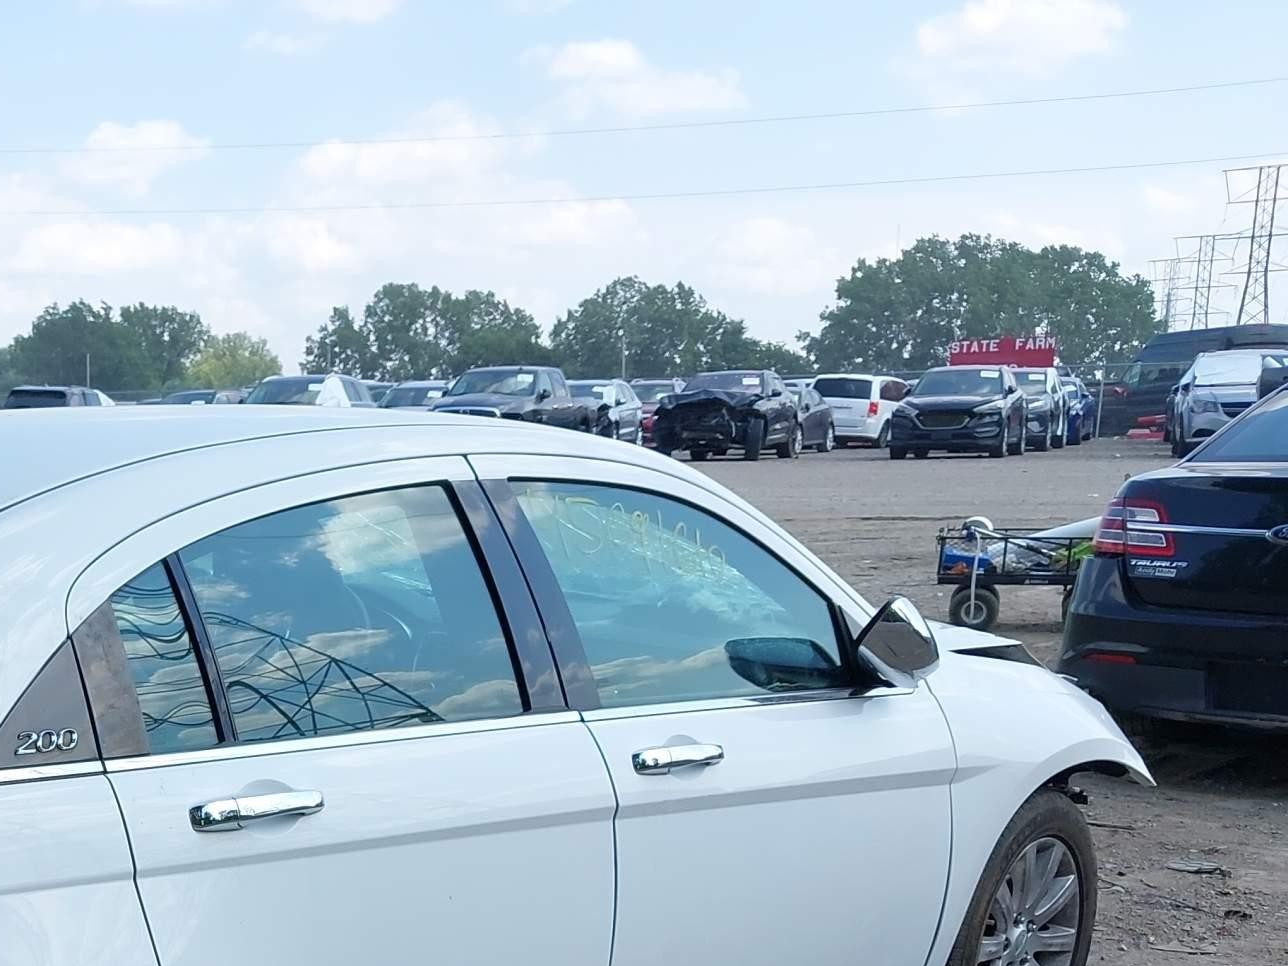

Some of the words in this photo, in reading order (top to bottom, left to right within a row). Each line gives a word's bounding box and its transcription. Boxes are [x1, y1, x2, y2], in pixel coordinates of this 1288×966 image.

[951, 340, 1000, 354] STATE
[1015, 337, 1056, 350] FARM
[1130, 559, 1189, 568] TAURUS
[15, 728, 79, 755] 200
